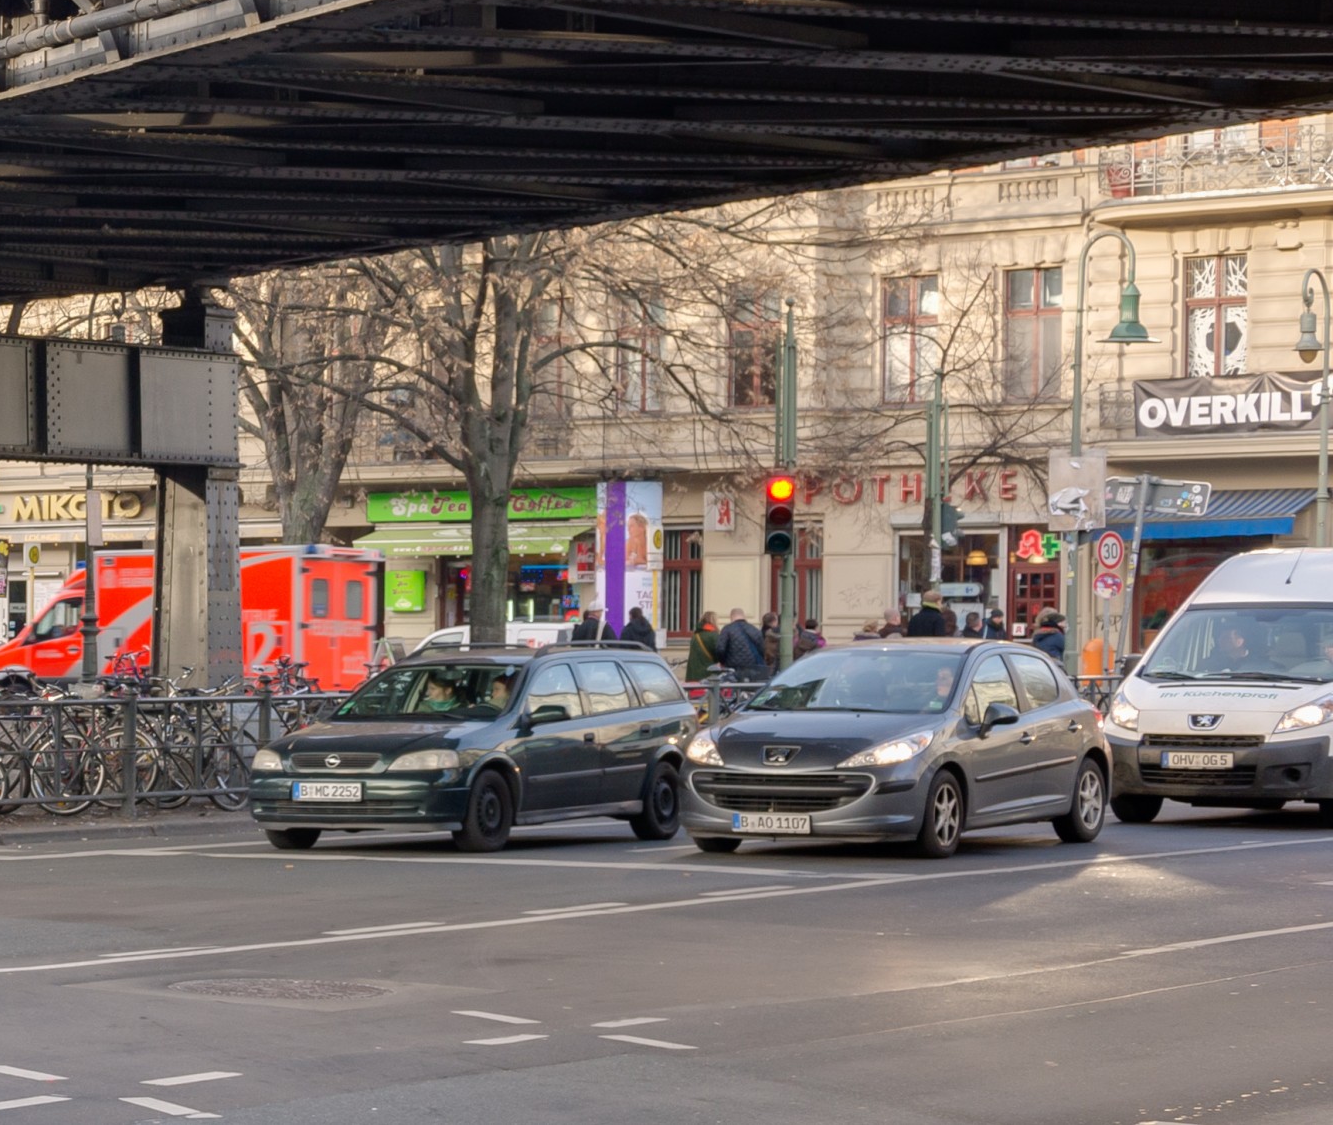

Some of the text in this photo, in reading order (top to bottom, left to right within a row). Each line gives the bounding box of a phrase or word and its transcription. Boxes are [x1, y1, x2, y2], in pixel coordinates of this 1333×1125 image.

[1139, 391, 1313, 428] OVERKILL
[804, 470, 1018, 505] POTHKE
[430, 496, 467, 515] Tea
[509, 493, 574, 513] Coffee
[1103, 542, 1119, 560] 30
[1183, 690, 1279, 700] Küchenprofi
[1172, 754, 1228, 766] OHV OG 5
[300, 785, 360, 798] B MC 2252
[741, 816, 807, 830] B AO 1107
